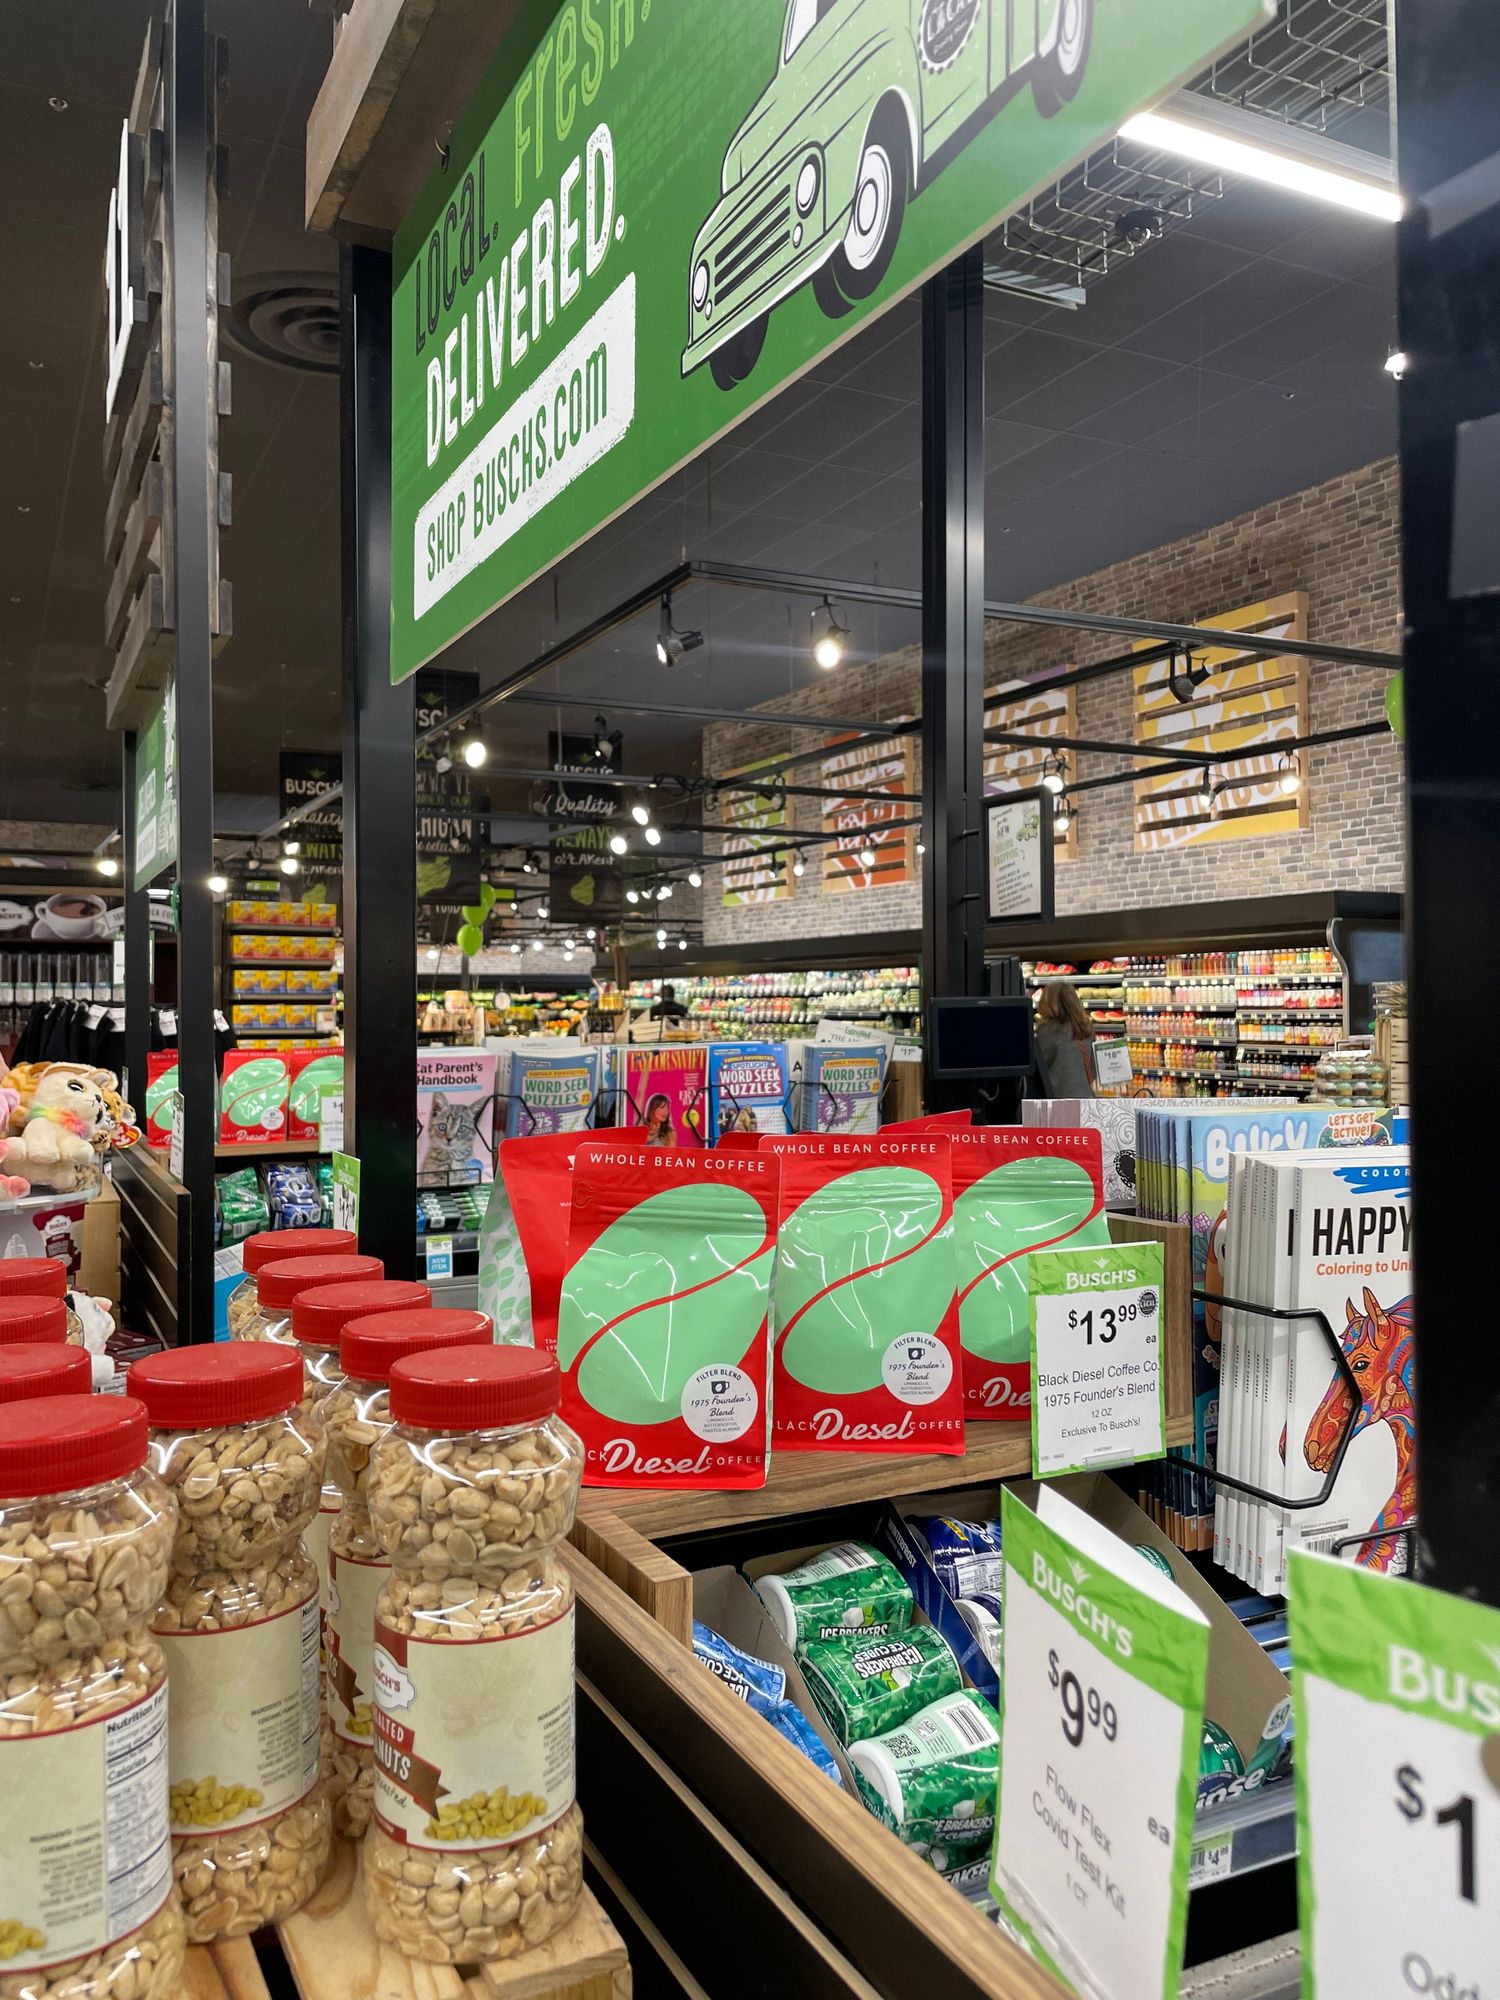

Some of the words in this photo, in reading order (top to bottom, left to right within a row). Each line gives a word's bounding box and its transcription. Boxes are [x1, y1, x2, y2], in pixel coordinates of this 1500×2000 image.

[426, 122, 626, 470] DELIVERED.
[427, 491, 466, 582] SHOP
[435, 1061, 483, 1073] Parent's
[671, 1050, 705, 1070] SWIFT
[730, 1062, 770, 1070] SPOTLIGHT
[416, 1073, 478, 1085] Handbook
[720, 1070, 753, 1083] WORD
[754, 1068, 781, 1080] SEEK
[823, 1068, 855, 1080] WORD
[857, 1067, 878, 1079] SEEK
[525, 1080, 562, 1093] WORD
[563, 1078, 589, 1091] SEEK
[720, 1082, 781, 1096] PUZZLES
[524, 1092, 578, 1105] PUZZLES
[993, 1134, 1030, 1145] BEAN
[1035, 1135, 1090, 1145] COFFEE
[773, 1144, 826, 1155] WHOLE
[832, 1143, 873, 1154] BEAN
[880, 1142, 938, 1154] COFFEE
[589, 1152, 646, 1166] WHOLE
[654, 1156, 696, 1168] BEAN
[704, 1158, 766, 1173] COFFEE
[431, 1264, 448, 1272] ITEM
[1316, 1260, 1373, 1276] Coloring
[1375, 1260, 1389, 1272] to
[1066, 1269, 1137, 1290] BUSCH'S
[894, 1336, 915, 1350] FILTER
[916, 1336, 937, 1349] BLEND
[1146, 1335, 1157, 1344] ea
[889, 1363, 907, 1371] 1975
[908, 1359, 946, 1370] Founder's
[696, 1368, 719, 1384] FILTER
[720, 1368, 742, 1381] BLEND
[906, 1371, 930, 1381] Blend
[1039, 1372, 1070, 1387] Black
[1072, 1367, 1105, 1383] Diesel
[1108, 1363, 1141, 1378] Coffee
[1144, 1360, 1158, 1373] Co
[690, 1398, 710, 1407] 1975
[711, 1392, 752, 1405] Founder's
[1044, 1393, 1071, 1408] 1975
[1074, 1385, 1125, 1404] Founder's
[1127, 1380, 1156, 1396] Blend
[709, 1407, 735, 1418] Blend
[1091, 1410, 1100, 1419] 12
[1101, 1407, 1113, 1417] OZ
[777, 1420, 819, 1431] LACK
[813, 1408, 915, 1440] Diesel
[909, 1419, 961, 1431] COFFEE
[1061, 1425, 1097, 1439] Exclusive
[1099, 1422, 1108, 1432] To
[604, 1438, 710, 1474] Diesel
[706, 1455, 762, 1466] COFFEE
[1032, 1550, 1134, 1658] BUSCH'S
[821, 1626, 840, 1639] ICE
[853, 1645, 890, 1662] CUBES
[886, 1641, 908, 1655] ICE
[902, 1644, 925, 1665] ICE
[853, 1653, 908, 1679] BREAKERS
[106, 1704, 153, 1734] Nutrition
[1046, 1764, 1077, 1817] Flow
[1081, 1803, 1113, 1858] Flex
[1147, 1813, 1171, 1846] ea
[1032, 1790, 1071, 1849] Covid
[1073, 1837, 1102, 1893] Test
[1105, 1876, 1127, 1920] Kit
